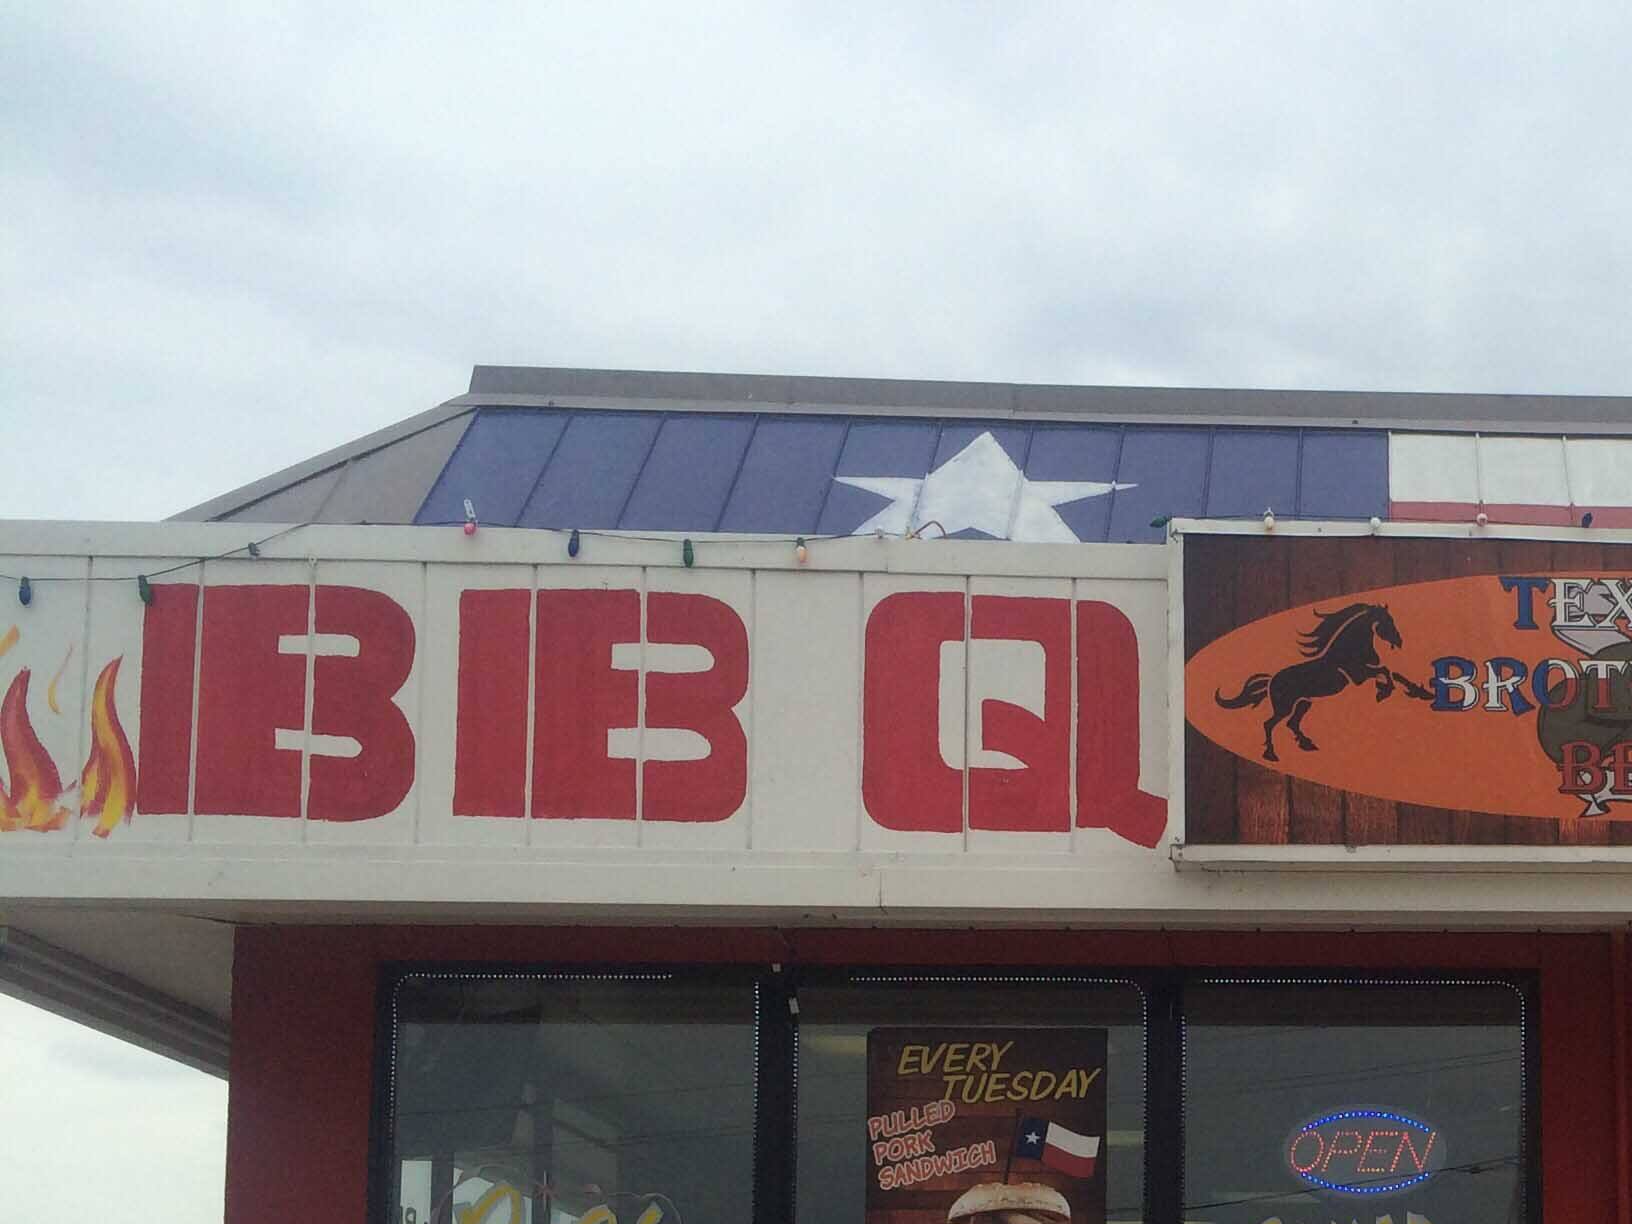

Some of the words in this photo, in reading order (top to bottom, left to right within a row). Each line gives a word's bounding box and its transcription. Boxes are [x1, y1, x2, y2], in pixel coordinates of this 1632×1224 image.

[137, 584, 1168, 849] BBQ
[898, 1040, 1014, 1075] EVERY
[942, 1067, 1101, 1103] TUESDAY
[868, 1099, 956, 1141] PULLED
[873, 1129, 935, 1166] PORK
[878, 1139, 996, 1191] SANDWICH
[1289, 1130, 1437, 1174] OPEN
